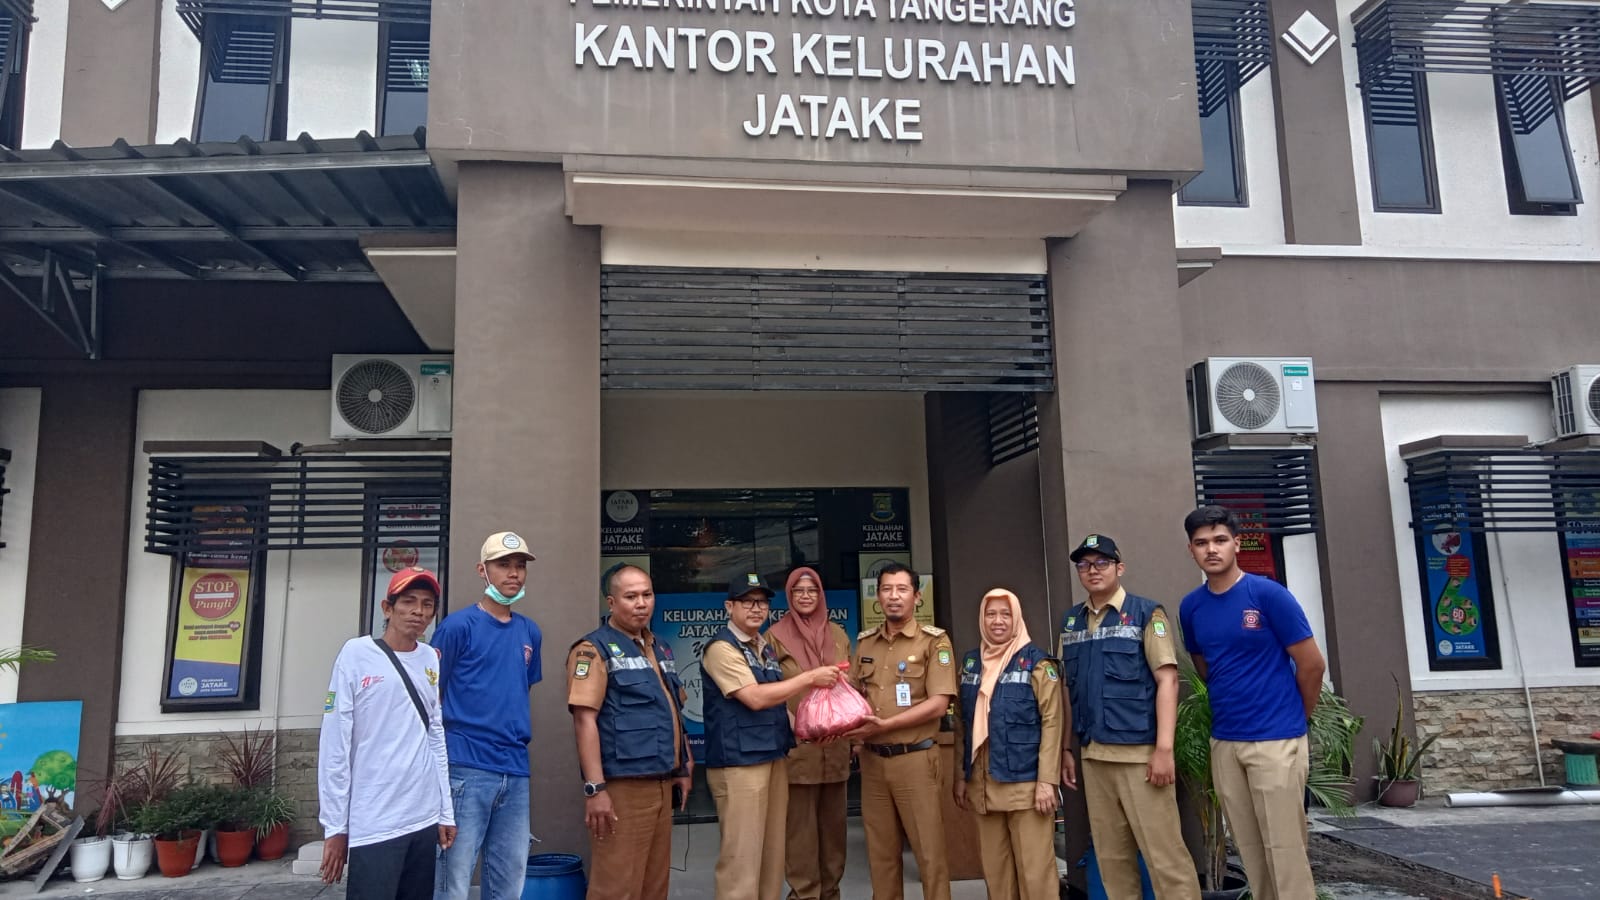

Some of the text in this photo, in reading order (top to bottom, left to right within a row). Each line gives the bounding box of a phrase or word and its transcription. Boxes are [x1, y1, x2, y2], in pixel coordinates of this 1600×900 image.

[888, 0, 1076, 28] TANGERANG
[575, 22, 1076, 85] KANTOR KELURAHAN
[743, 94, 923, 141] JATAKE
[603, 534, 642, 544] JATAKE
[865, 532, 903, 541] JATAKE
[195, 581, 234, 593] STOP
[196, 597, 232, 610] Pungli
[663, 610, 730, 622] KELURAHA
[1453, 608, 1464, 619] 60
